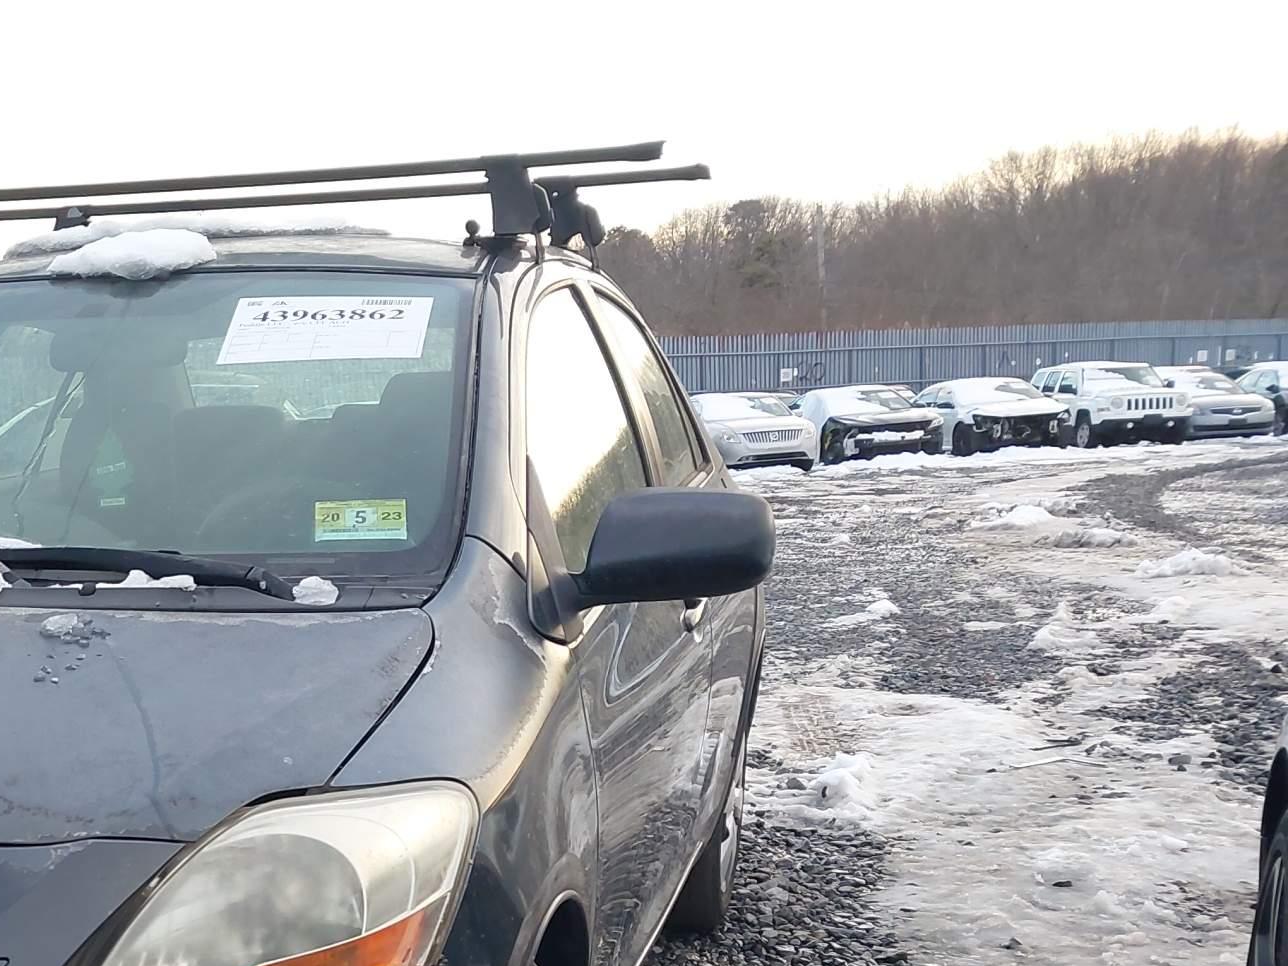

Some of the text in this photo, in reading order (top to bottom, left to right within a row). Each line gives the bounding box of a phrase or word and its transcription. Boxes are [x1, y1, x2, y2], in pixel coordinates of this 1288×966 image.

[252, 309, 405, 322] 43963862
[321, 510, 402, 524] 20 5 23
